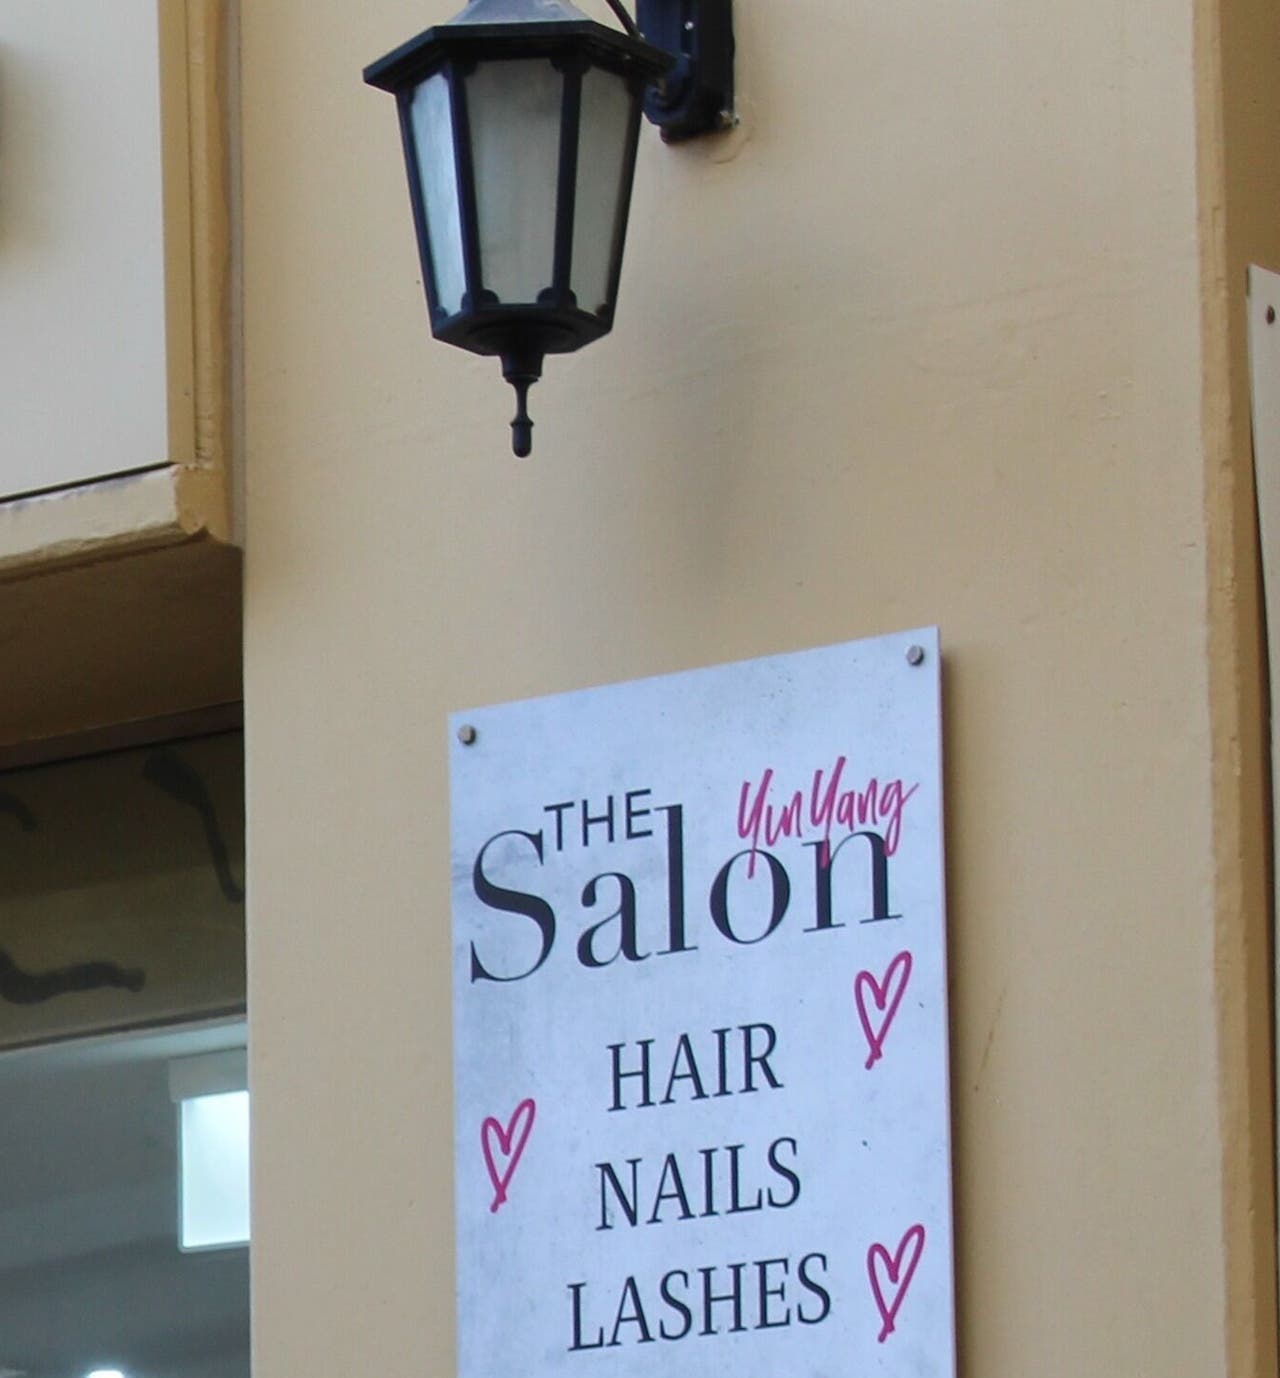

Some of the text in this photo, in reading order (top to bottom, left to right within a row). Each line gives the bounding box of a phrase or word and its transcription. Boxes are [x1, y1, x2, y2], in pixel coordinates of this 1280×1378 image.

[544, 789, 653, 851] THE
[738, 756, 920, 880] Yin Yang
[469, 803, 904, 985] Salon
[606, 1021, 784, 1112] HAIR
[595, 1136, 802, 1231] NAILS
[566, 1252, 832, 1352] LASHES
